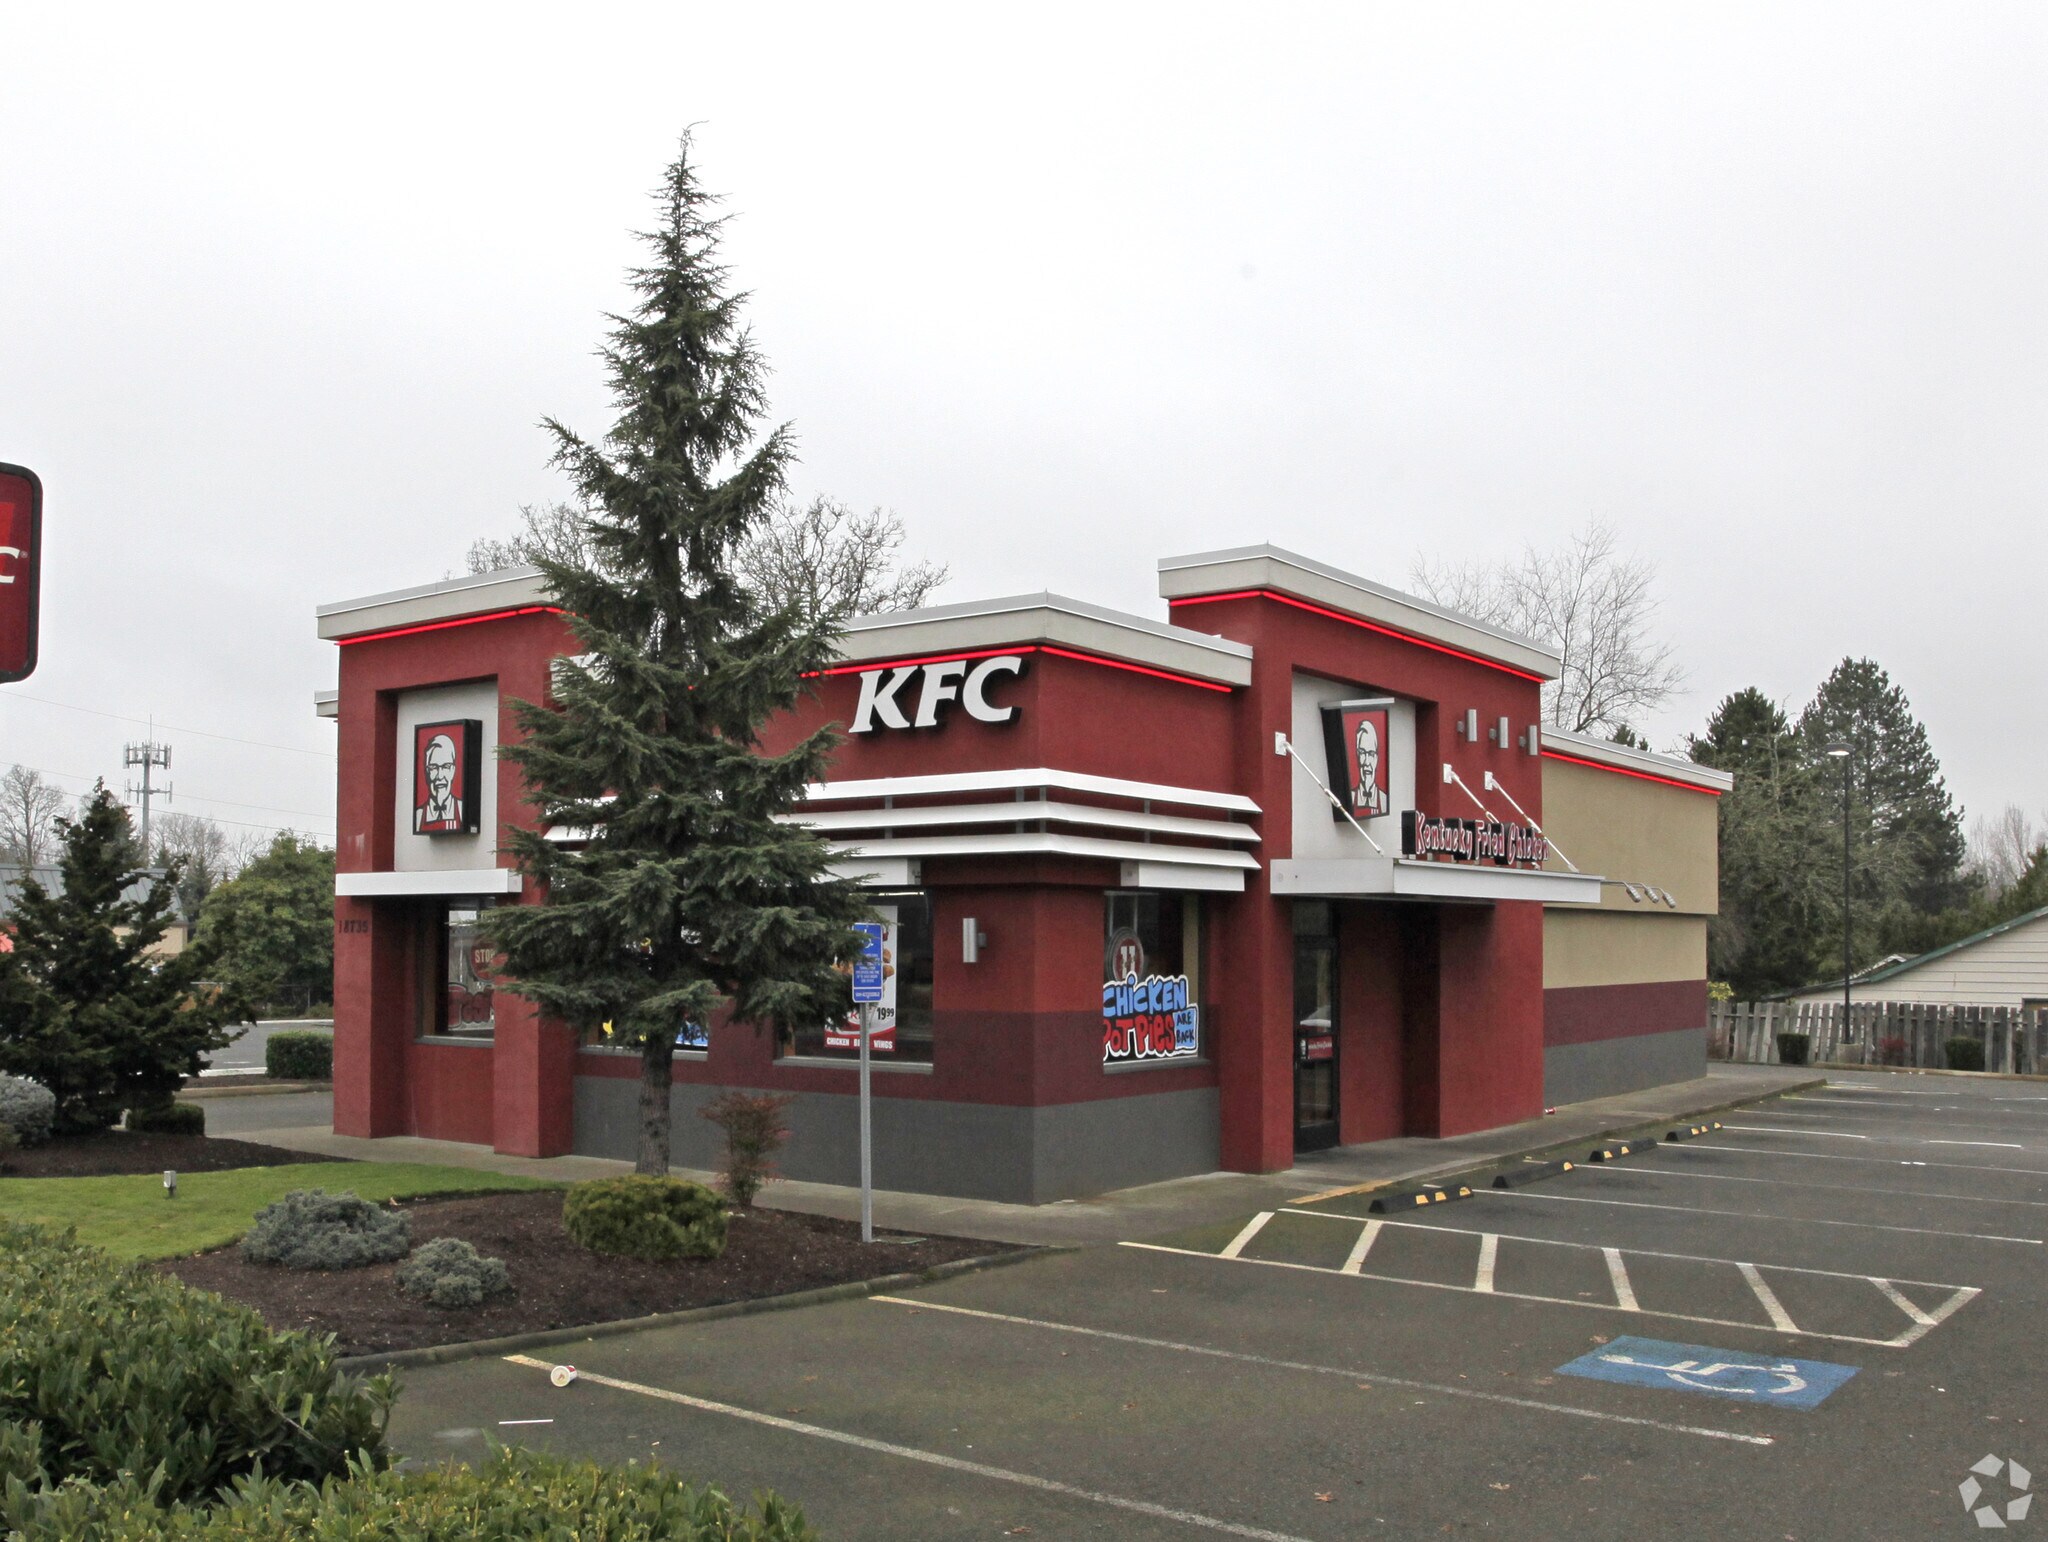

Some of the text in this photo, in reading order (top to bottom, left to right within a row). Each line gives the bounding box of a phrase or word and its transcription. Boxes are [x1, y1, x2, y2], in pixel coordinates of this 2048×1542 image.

[848, 655, 1022, 734] KFC
[1414, 810, 1549, 866] Kentucky Fried Chicken
[338, 919, 369, 934] 18735
[1176, 1011, 1192, 1026] ARE
[1176, 1029, 1195, 1044] BACK
[873, 1039, 893, 1050] WINGS
